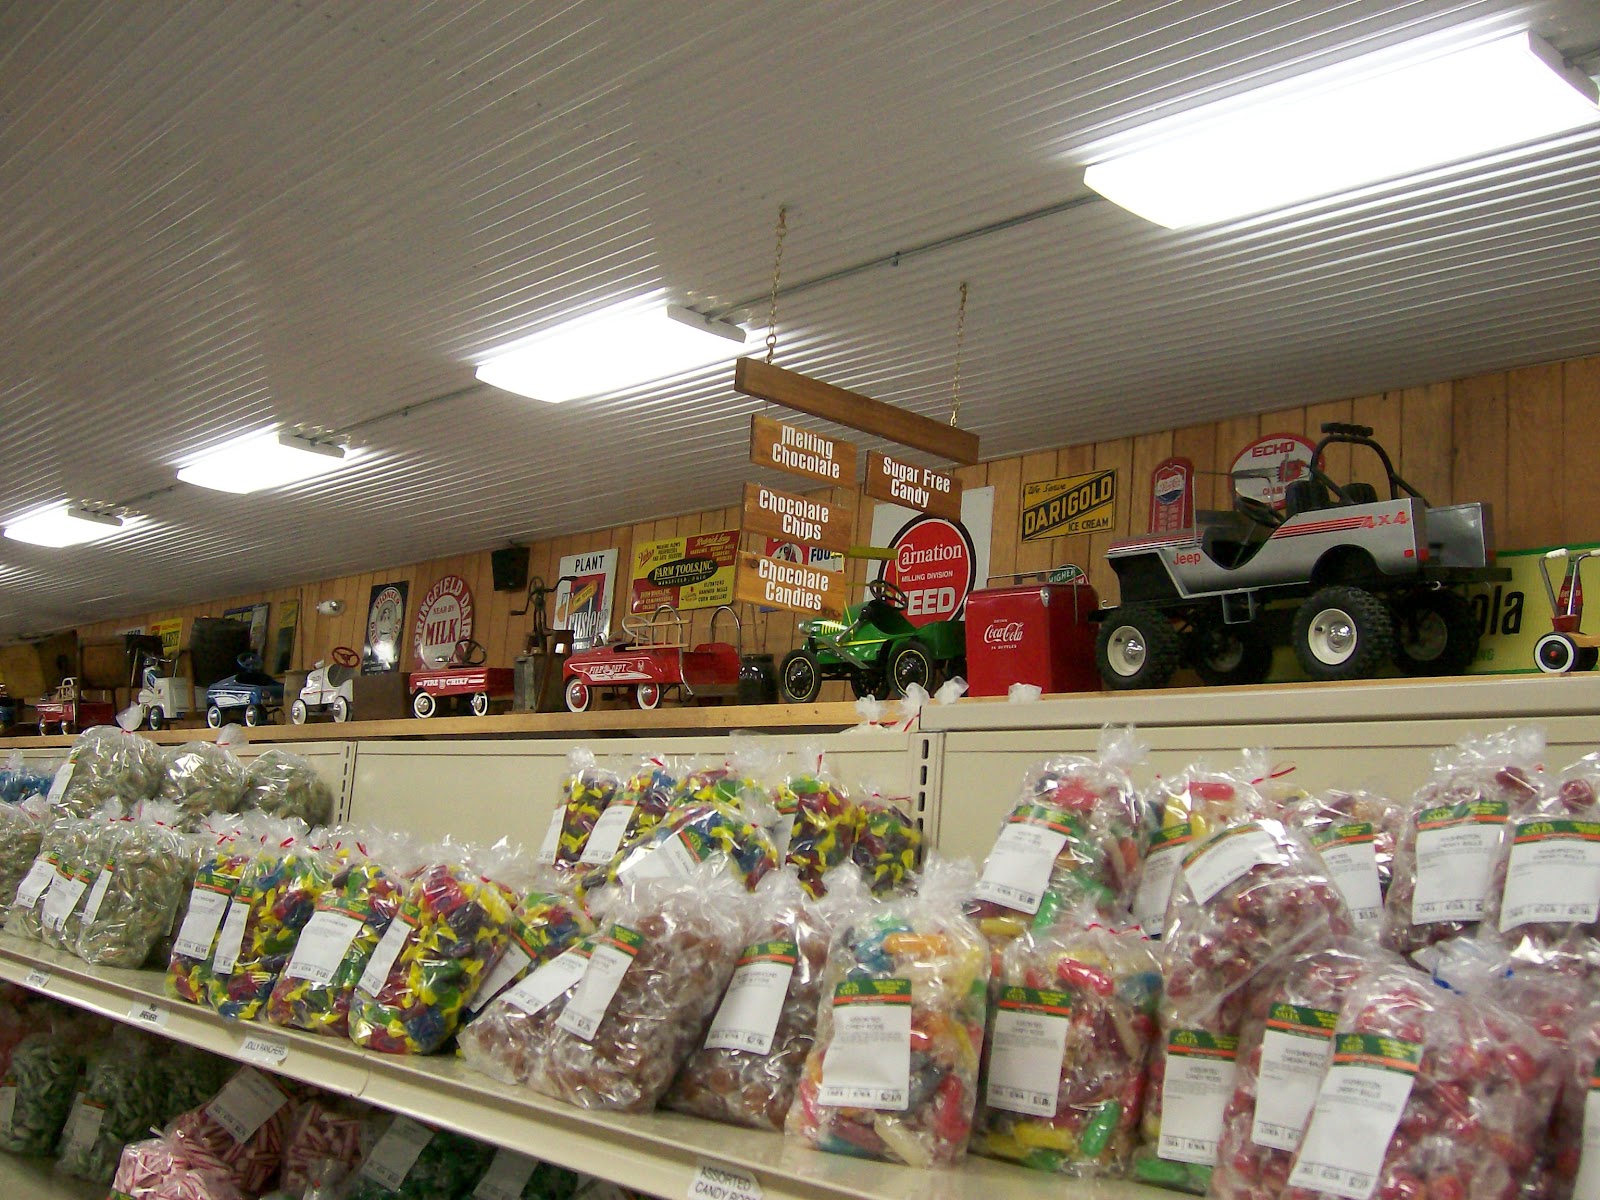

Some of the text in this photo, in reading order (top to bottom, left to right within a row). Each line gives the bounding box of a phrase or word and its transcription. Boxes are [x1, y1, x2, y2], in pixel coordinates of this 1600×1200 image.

[781, 425, 834, 459] Melting
[1252, 441, 1295, 458] ECHO
[772, 443, 840, 479] Chocolate
[882, 456, 951, 493] Sugar Free
[759, 489, 829, 523] Chocolate
[890, 478, 930, 508] Candy
[1024, 477, 1112, 536] DARIGOLD
[782, 513, 822, 541] Chips
[1068, 517, 1109, 532] ICE CREAM
[575, 555, 605, 573] PLANT
[897, 543, 962, 572] Carnation
[1172, 550, 1201, 566] Jeep
[654, 567, 674, 580] FARM
[758, 558, 829, 592] Chocolate
[901, 570, 953, 582] MILLING DIVISION
[765, 581, 822, 611] Candies
[413, 576, 463, 658] SPRINGFIELD
[425, 617, 459, 646] MILK
[422, 677, 469, 687] FIRE CHIEF
[695, 1180, 729, 1199] CANDY
[701, 1165, 751, 1191] ASSORTED
